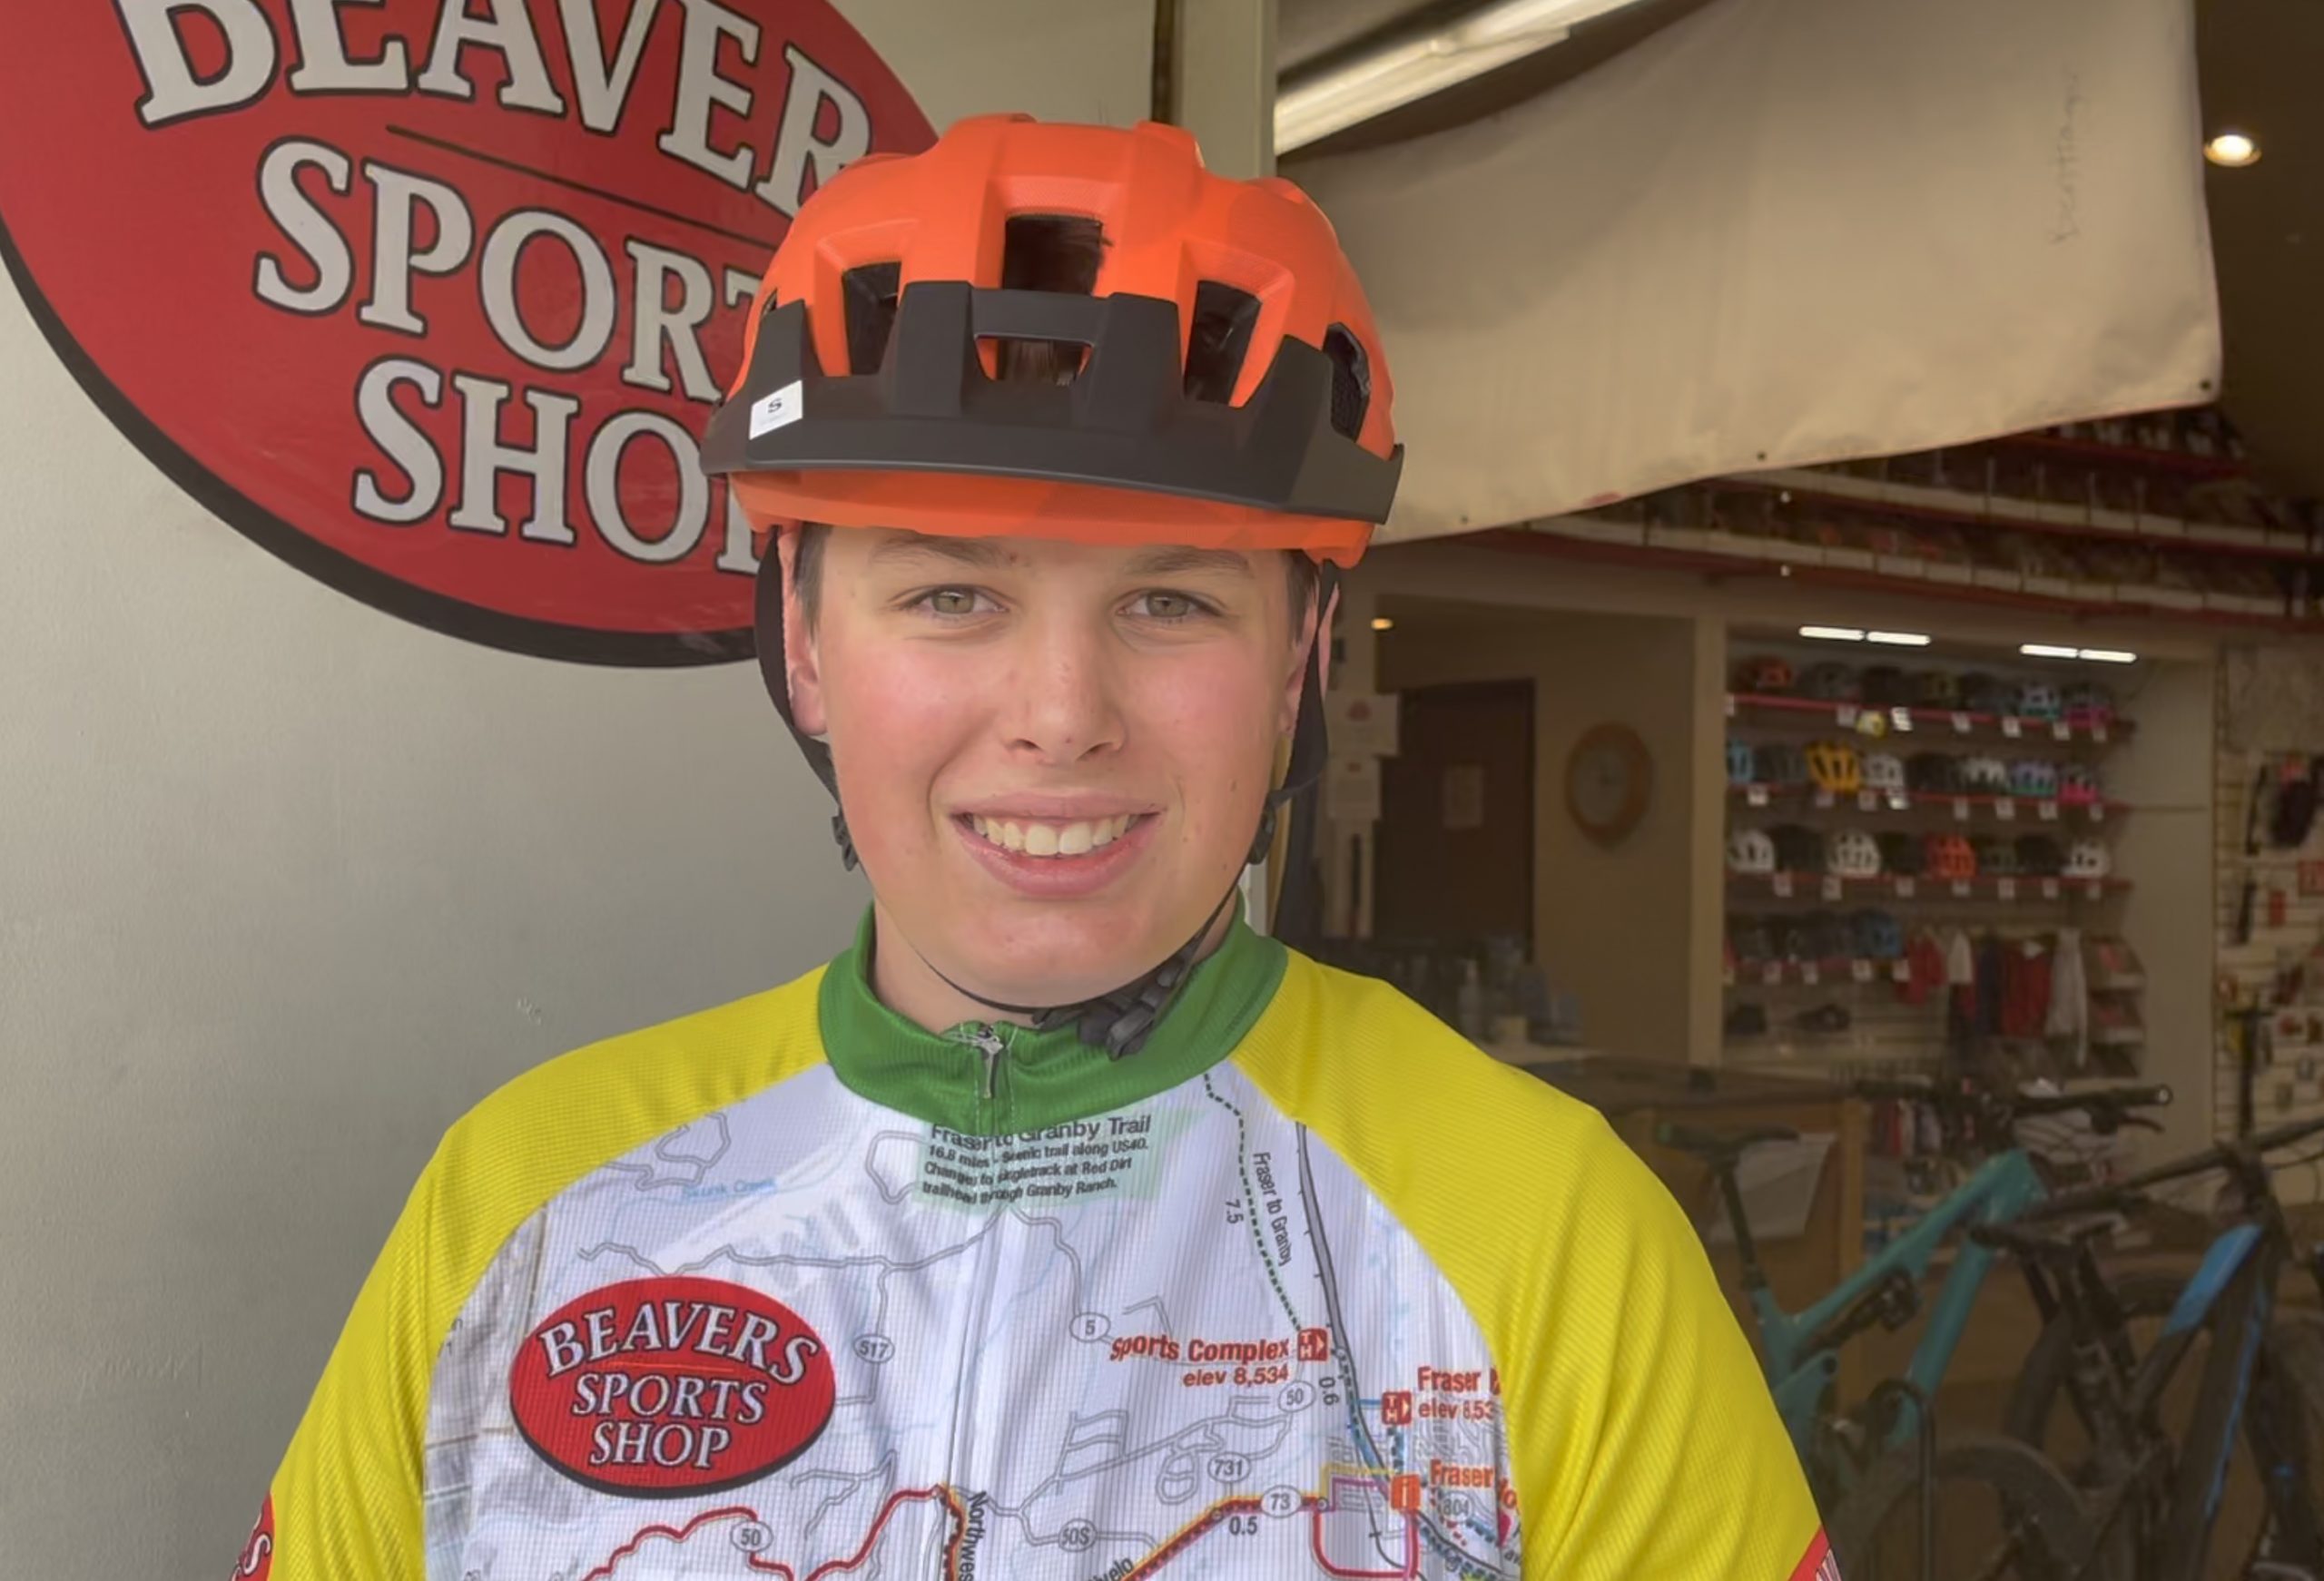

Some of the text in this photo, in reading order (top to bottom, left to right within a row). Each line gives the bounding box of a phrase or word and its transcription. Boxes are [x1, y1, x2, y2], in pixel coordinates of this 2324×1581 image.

[768, 398, 782, 413] S
[352, 358, 761, 574] SHO
[1108, 1115, 1151, 1135] Trail
[929, 1145, 956, 1161] 16.8
[1045, 1143, 1069, 1157] trail
[1072, 1142, 1108, 1157] along
[980, 1173, 994, 1185] to
[1064, 1163, 1078, 1175] at
[1081, 1161, 1108, 1175] Red
[1109, 1157, 1133, 1172] Dirt
[1027, 1183, 1073, 1198] Granby
[1226, 1199, 1245, 1224] 7.5
[1253, 1151, 1292, 1267] Fraser to Granby
[538, 1300, 818, 1385] BEAVERS
[859, 1339, 889, 1360] 517
[1188, 1338, 1290, 1364] Complex
[1182, 1362, 1289, 1388] elev 8,534
[571, 1371, 770, 1424] SPORTS
[1286, 1388, 1305, 1406] 50
[1318, 1377, 1340, 1406] 0.6
[1418, 1398, 1458, 1419] elev
[588, 1419, 732, 1470] SHOP
[1214, 1458, 1243, 1476] 731
[1430, 1458, 1494, 1488] Fraser
[1270, 1492, 1291, 1510] 73
[741, 1527, 762, 1546] 50
[1228, 1516, 1257, 1536] 0.5
